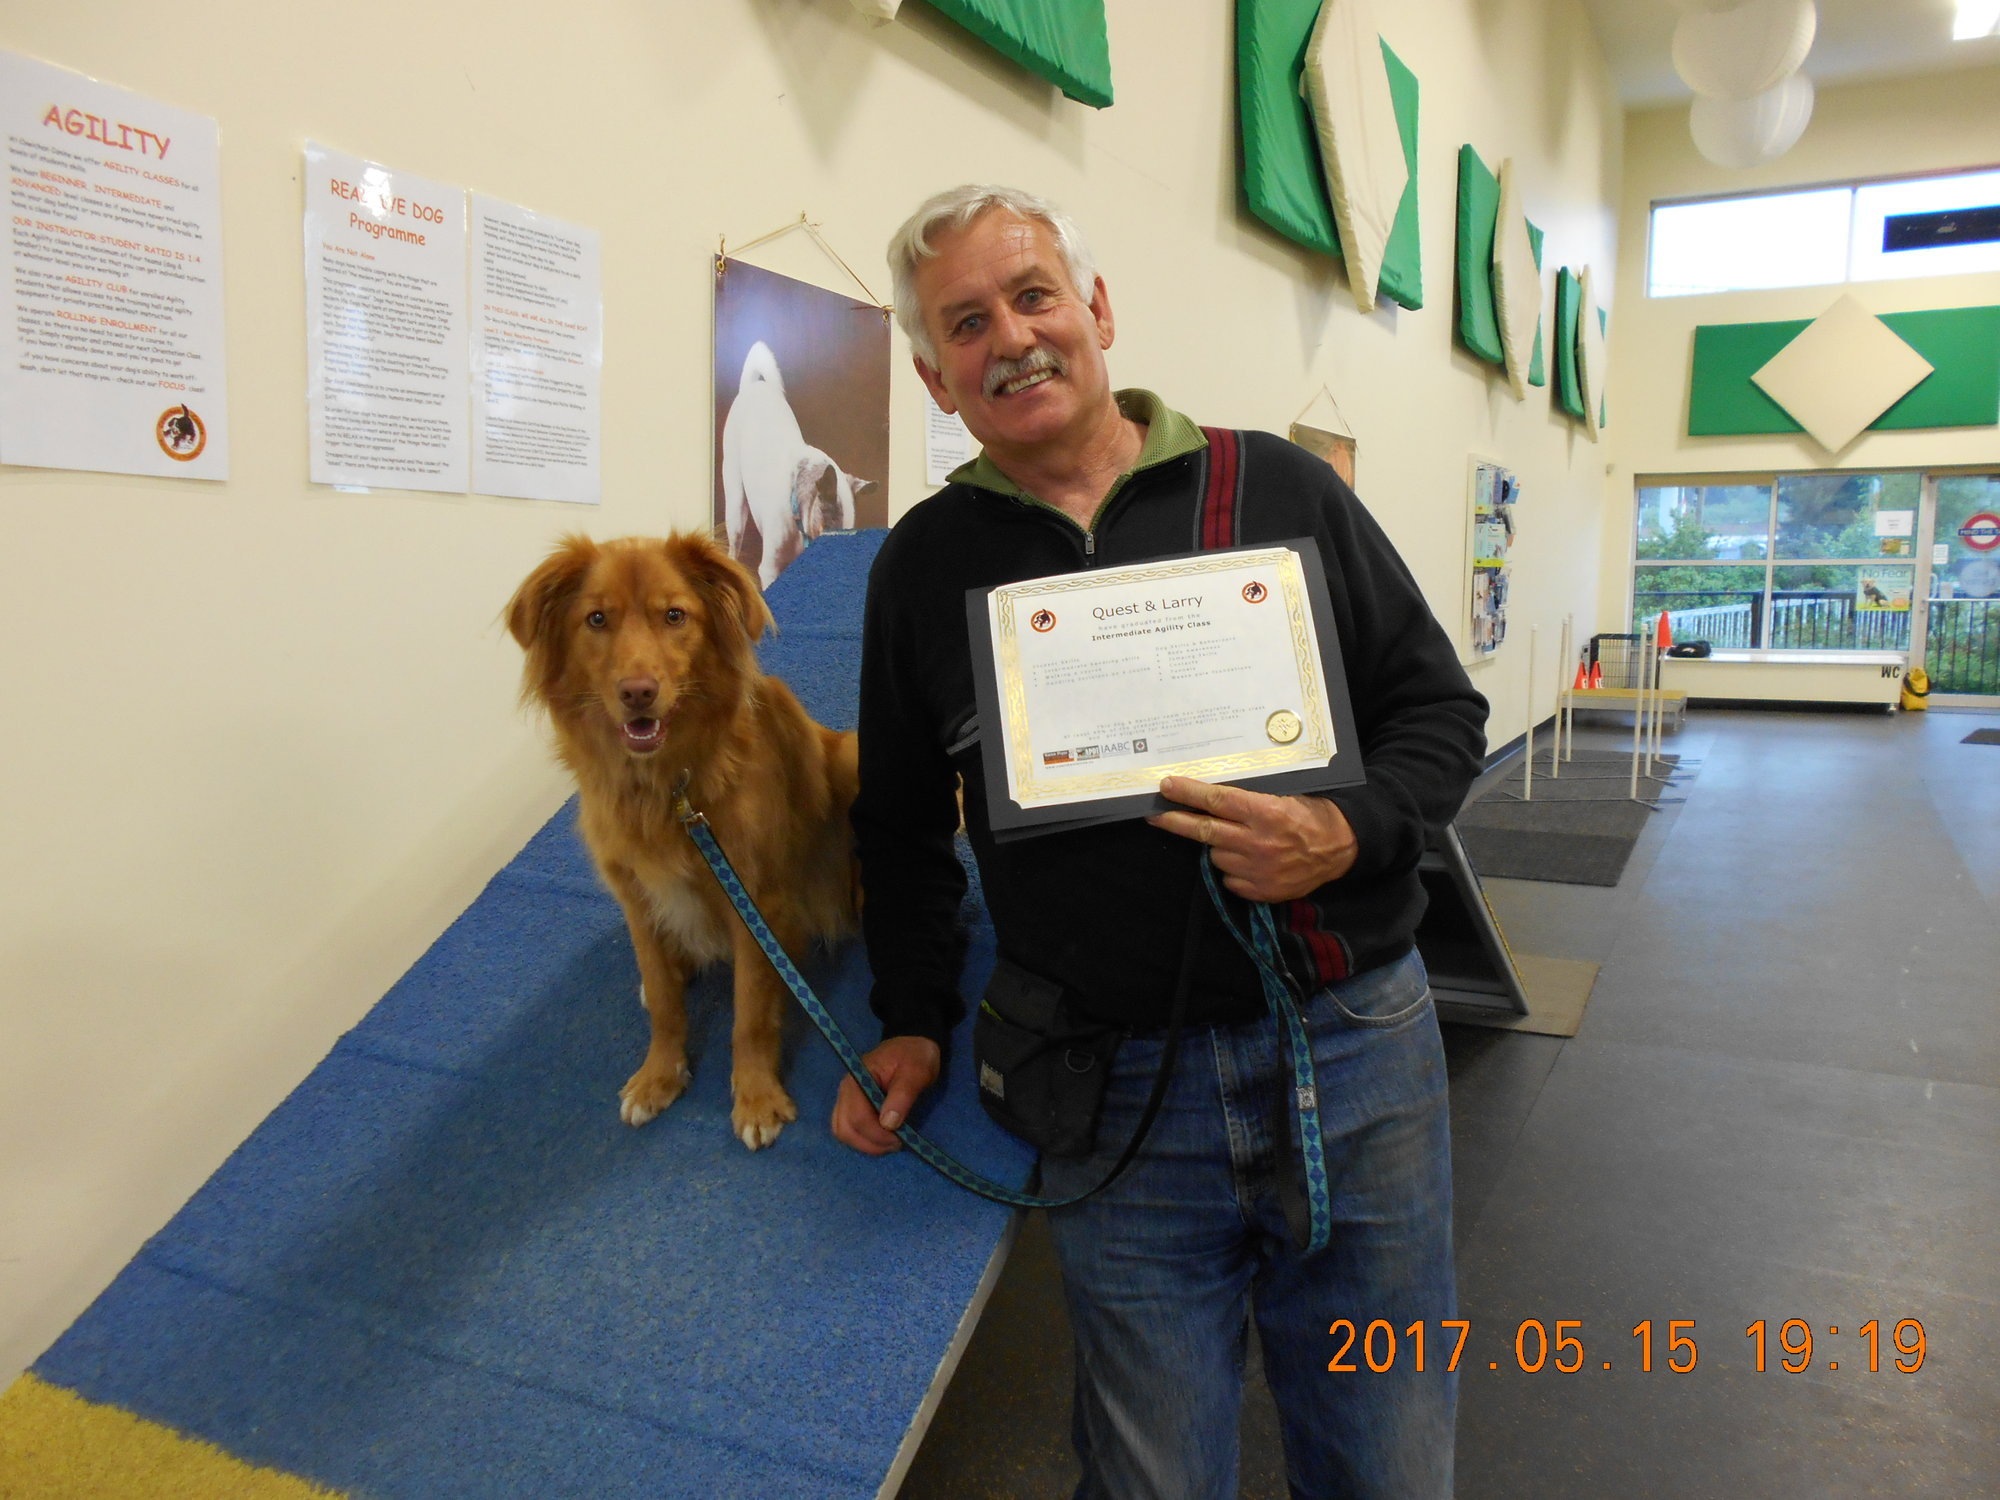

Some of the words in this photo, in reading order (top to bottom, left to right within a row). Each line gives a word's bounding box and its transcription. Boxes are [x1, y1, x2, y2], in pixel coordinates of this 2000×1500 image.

[44, 104, 171, 160] AGILITY
[102, 159, 139, 176] AGILITY
[142, 170, 179, 187] CLASSES
[93, 184, 161, 208] INTERMEDIATE
[413, 203, 444, 224] DOG
[11, 215, 33, 227] OUR
[99, 235, 140, 251] STUDENT
[144, 245, 171, 258] RATIO
[174, 251, 184, 260] IS
[350, 212, 426, 246] Programme
[64, 274, 102, 288] AGILITY
[105, 282, 128, 293] CLUB
[56, 309, 96, 323] ROLLING
[99, 317, 157, 333] ENROLLMENT
[158, 380, 185, 390] FOCUS
[1862, 568, 1880, 578] No
[1882, 568, 1908, 578] Fear
[1092, 602, 1140, 620] Quest
[1145, 600, 1156, 612] &
[1162, 596, 1202, 610] Larry
[1092, 628, 1152, 641] Intermediate
[1155, 624, 1184, 634] Agility
[1188, 620, 1212, 629] Class
[1122, 618, 1161, 629] graduated
[1166, 614, 1184, 622] from
[1881, 666, 1900, 678] WC
[1101, 741, 1130, 753] IAABC
